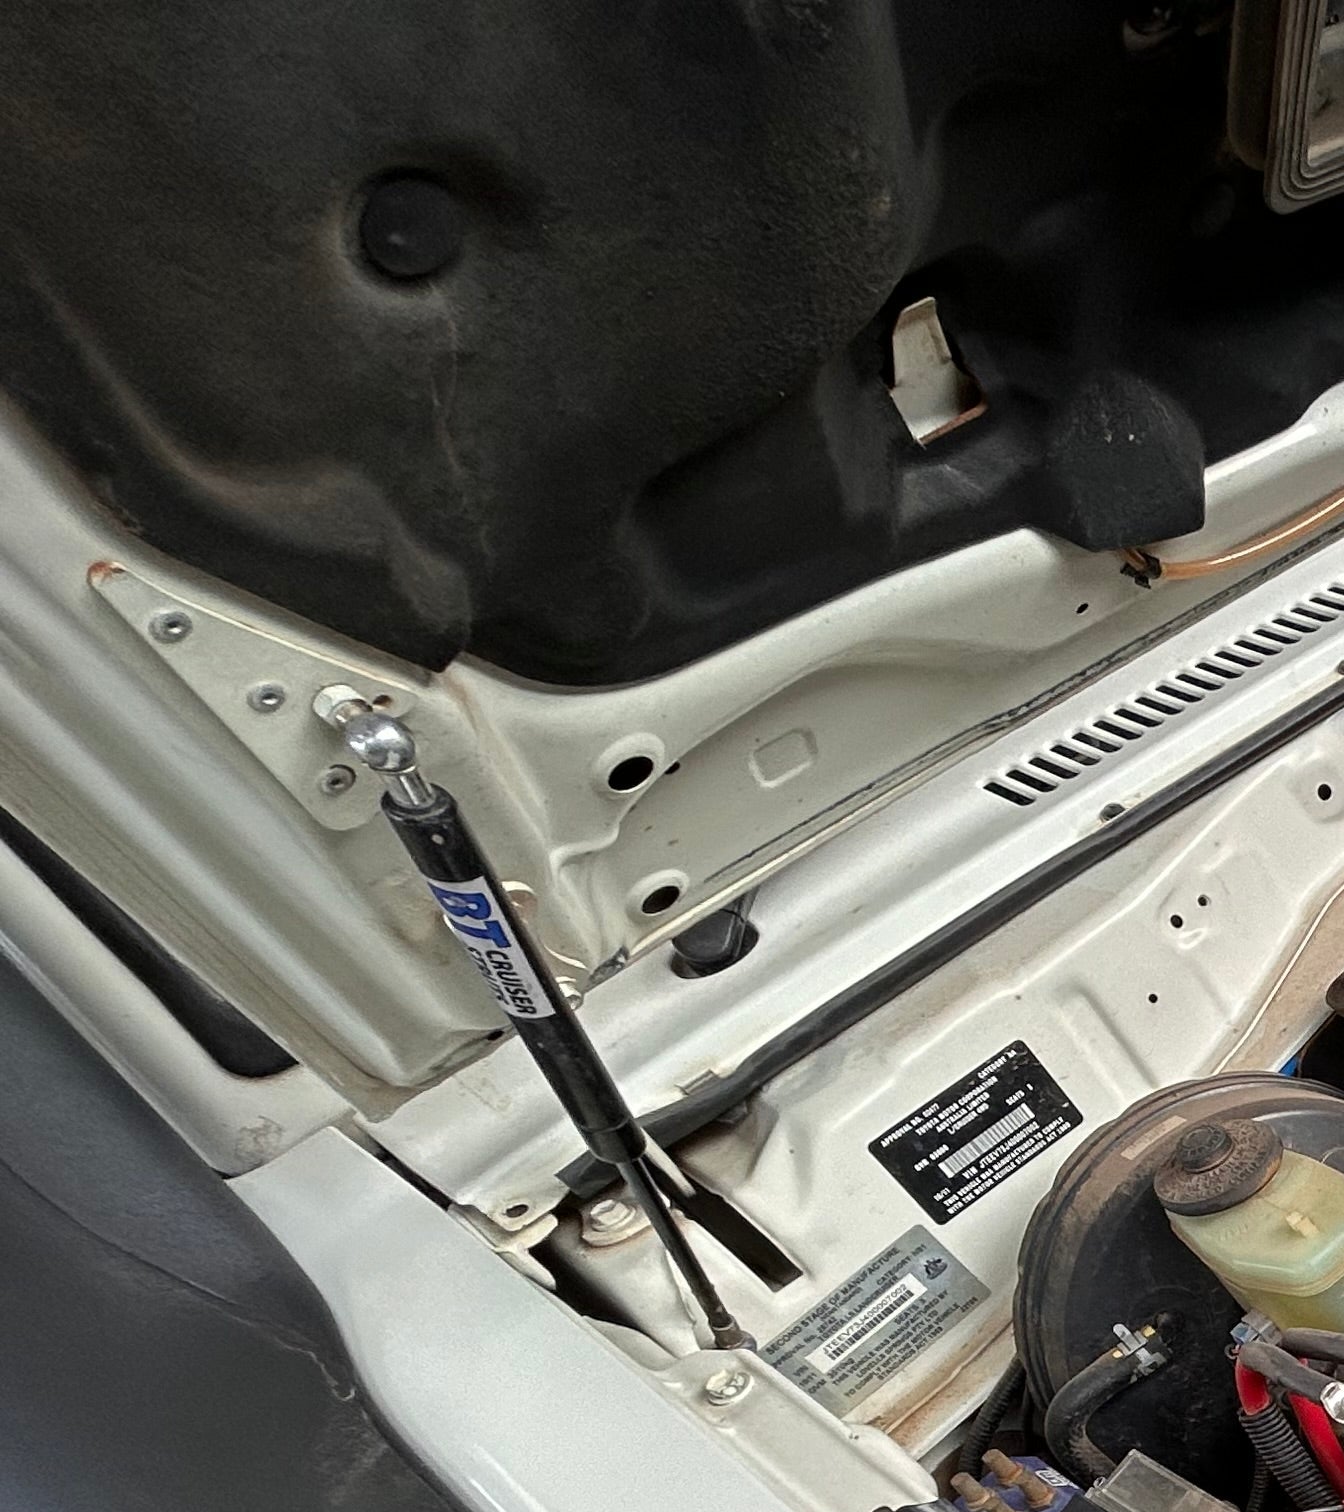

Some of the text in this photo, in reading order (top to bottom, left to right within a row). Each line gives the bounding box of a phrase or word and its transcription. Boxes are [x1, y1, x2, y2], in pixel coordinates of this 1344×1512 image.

[427, 881, 512, 949] BT
[485, 950, 537, 1014] CRUISER
[976, 1055, 1007, 1079] CATEGORY
[915, 1074, 998, 1136] TOYOTA MOTOR CORPORATION
[934, 1091, 990, 1133] AUSTRALIA LIMITED
[1004, 1088, 1025, 1106] SEATS
[879, 1122, 913, 1147] APPROVAL
[942, 1116, 1064, 1207] THIS VEHICLE WAS MANUFACTURED TO COMPLY
[946, 1200, 964, 1214] WITH
[961, 1192, 975, 1204] THE
[973, 1177, 994, 1195] MOTOR
[1044, 1130, 1058, 1142] ACT
[961, 1165, 978, 1180] VIN
[874, 1255, 912, 1285] CATEGORY
[764, 1246, 900, 1355] SECOND STAGE OF MANUFACTURE
[893, 1303, 919, 1325] SEATS
[817, 1318, 846, 1342] TOYOTA
[832, 1289, 949, 1386] THIS VEHICLE WAS MANUFACTURED BY
[844, 1302, 960, 1398] TO COMPLY WITH THE MOTOR VEHICLE
[793, 1364, 809, 1377] VIN
[876, 1348, 916, 1381] STANDARDS
[913, 1336, 929, 1350] ACT
[807, 1378, 827, 1394] GVM
